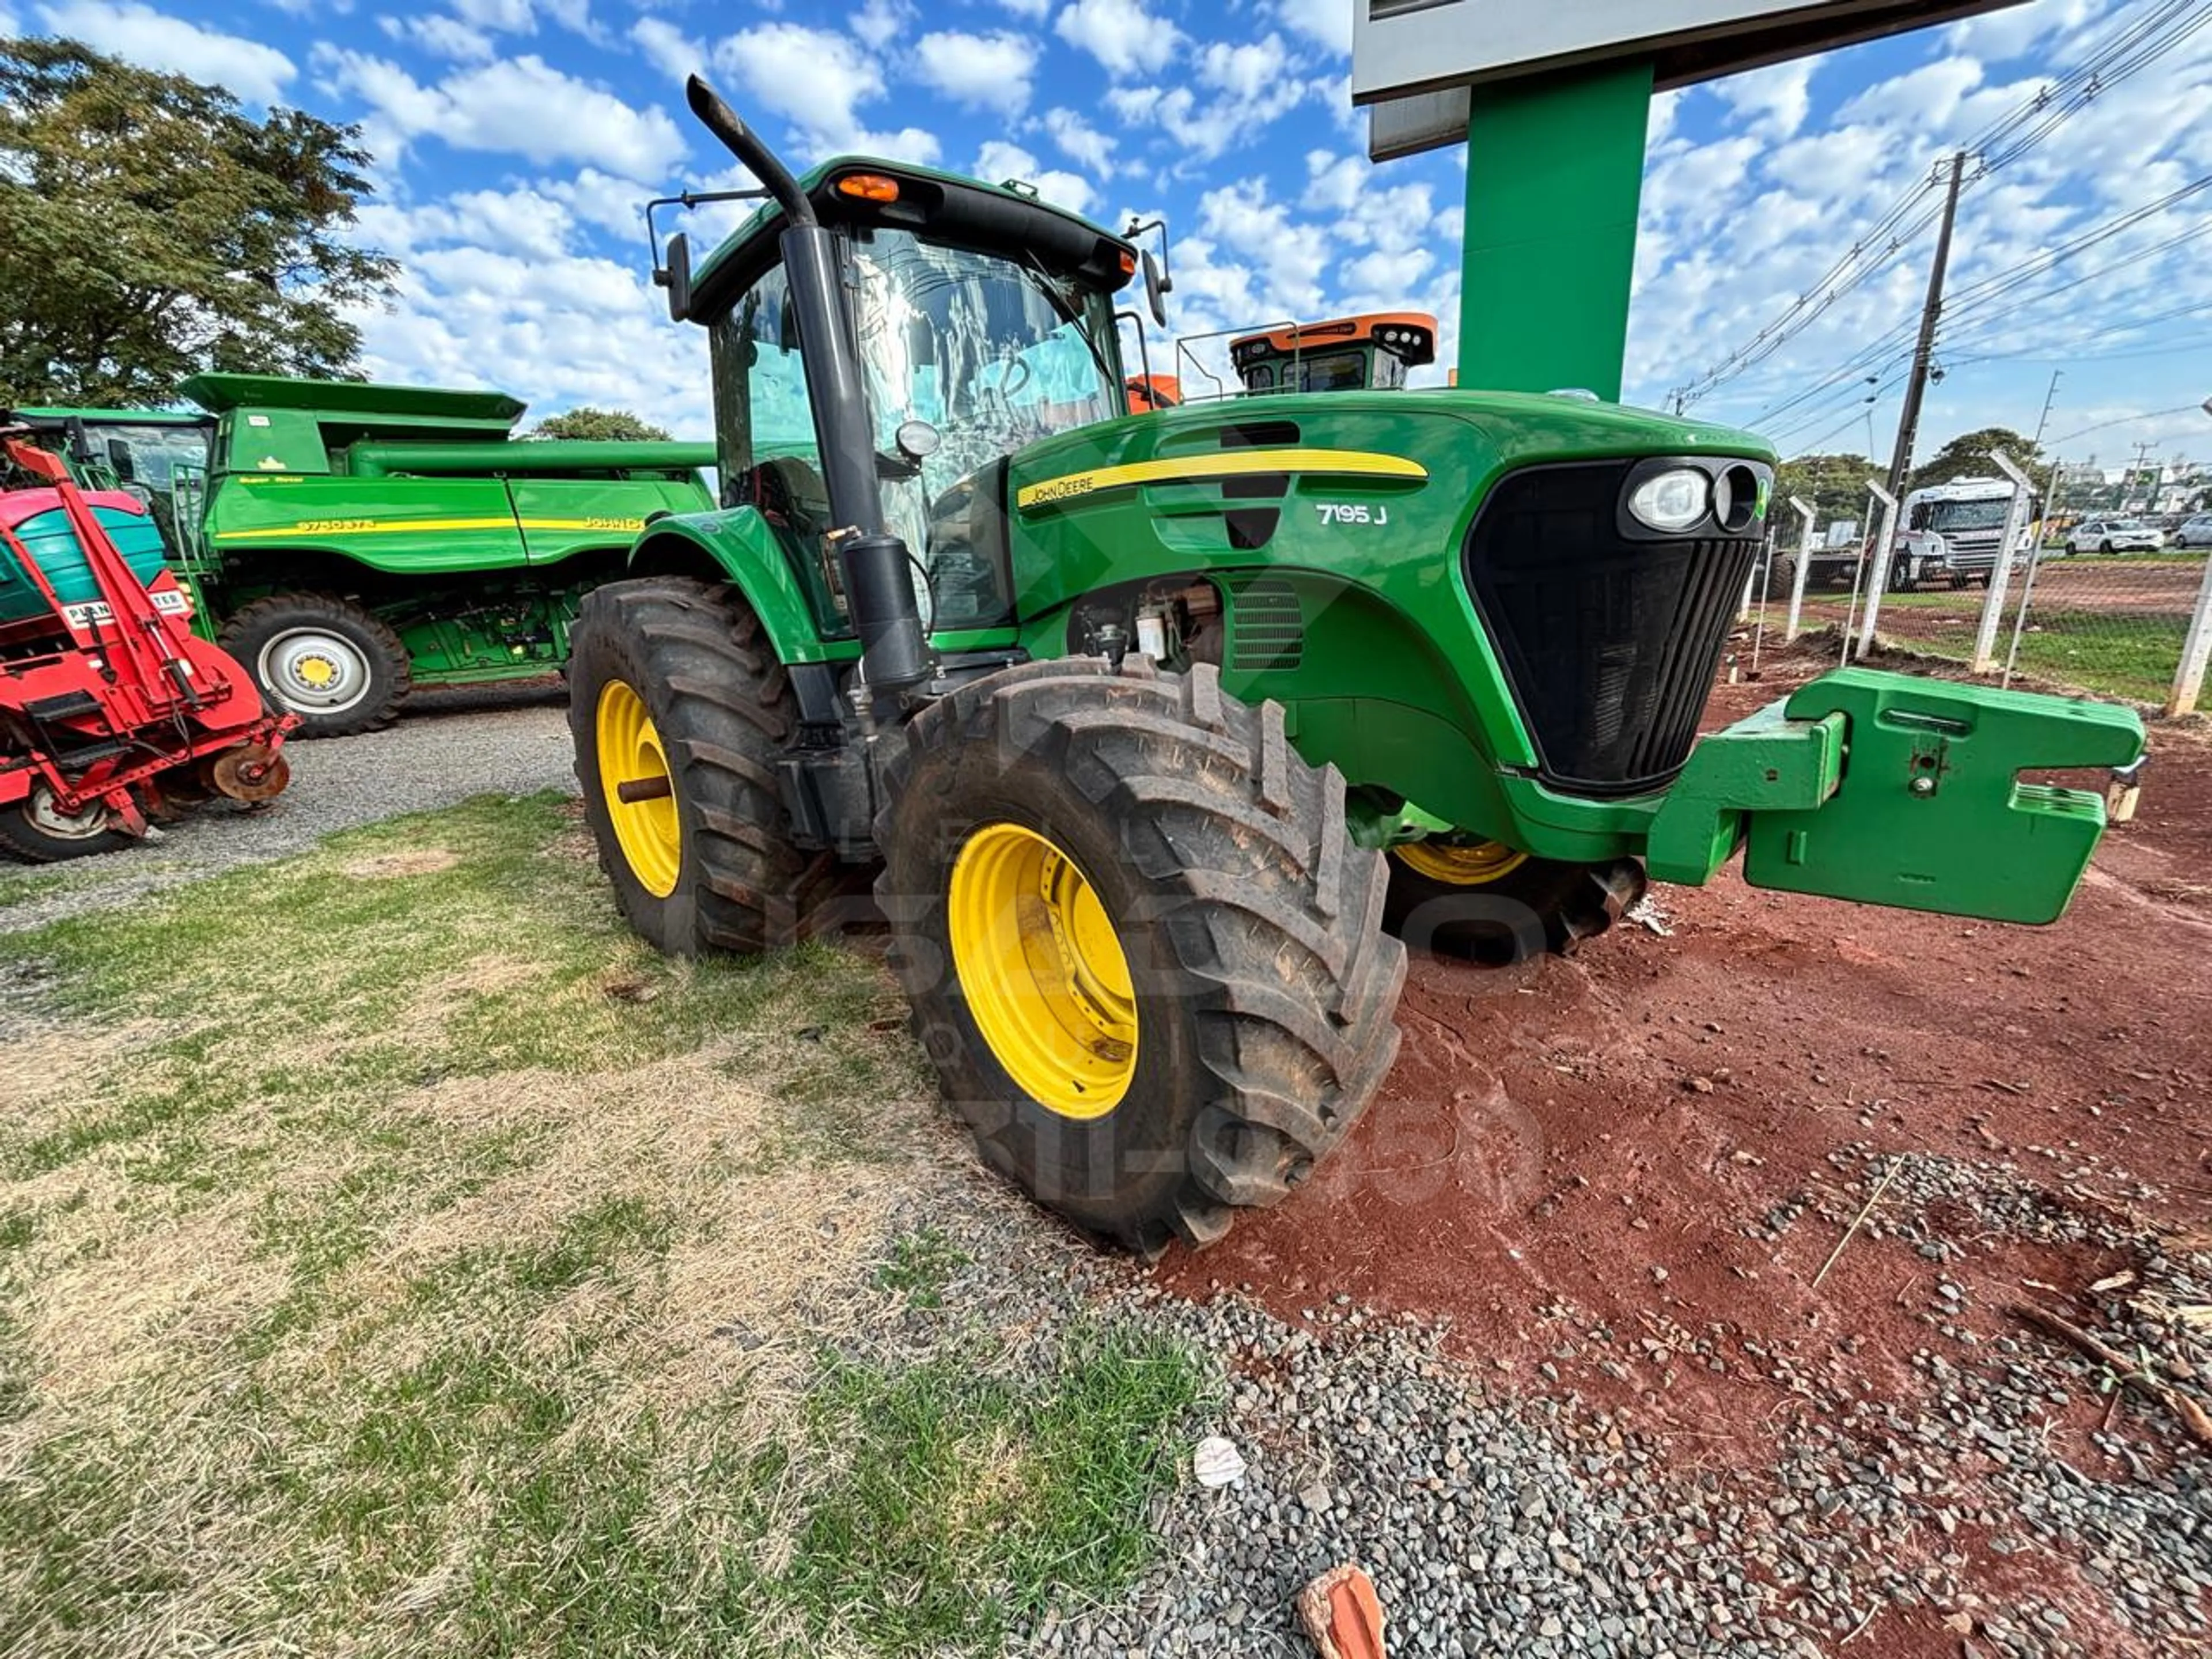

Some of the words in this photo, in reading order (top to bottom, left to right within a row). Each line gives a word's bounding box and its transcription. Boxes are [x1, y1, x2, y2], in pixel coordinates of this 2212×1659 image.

[1032, 485, 1056, 502] JOHN
[1058, 476, 1093, 496] DEERE
[1316, 504, 1370, 525] 7195
[1373, 506, 1387, 525] J
